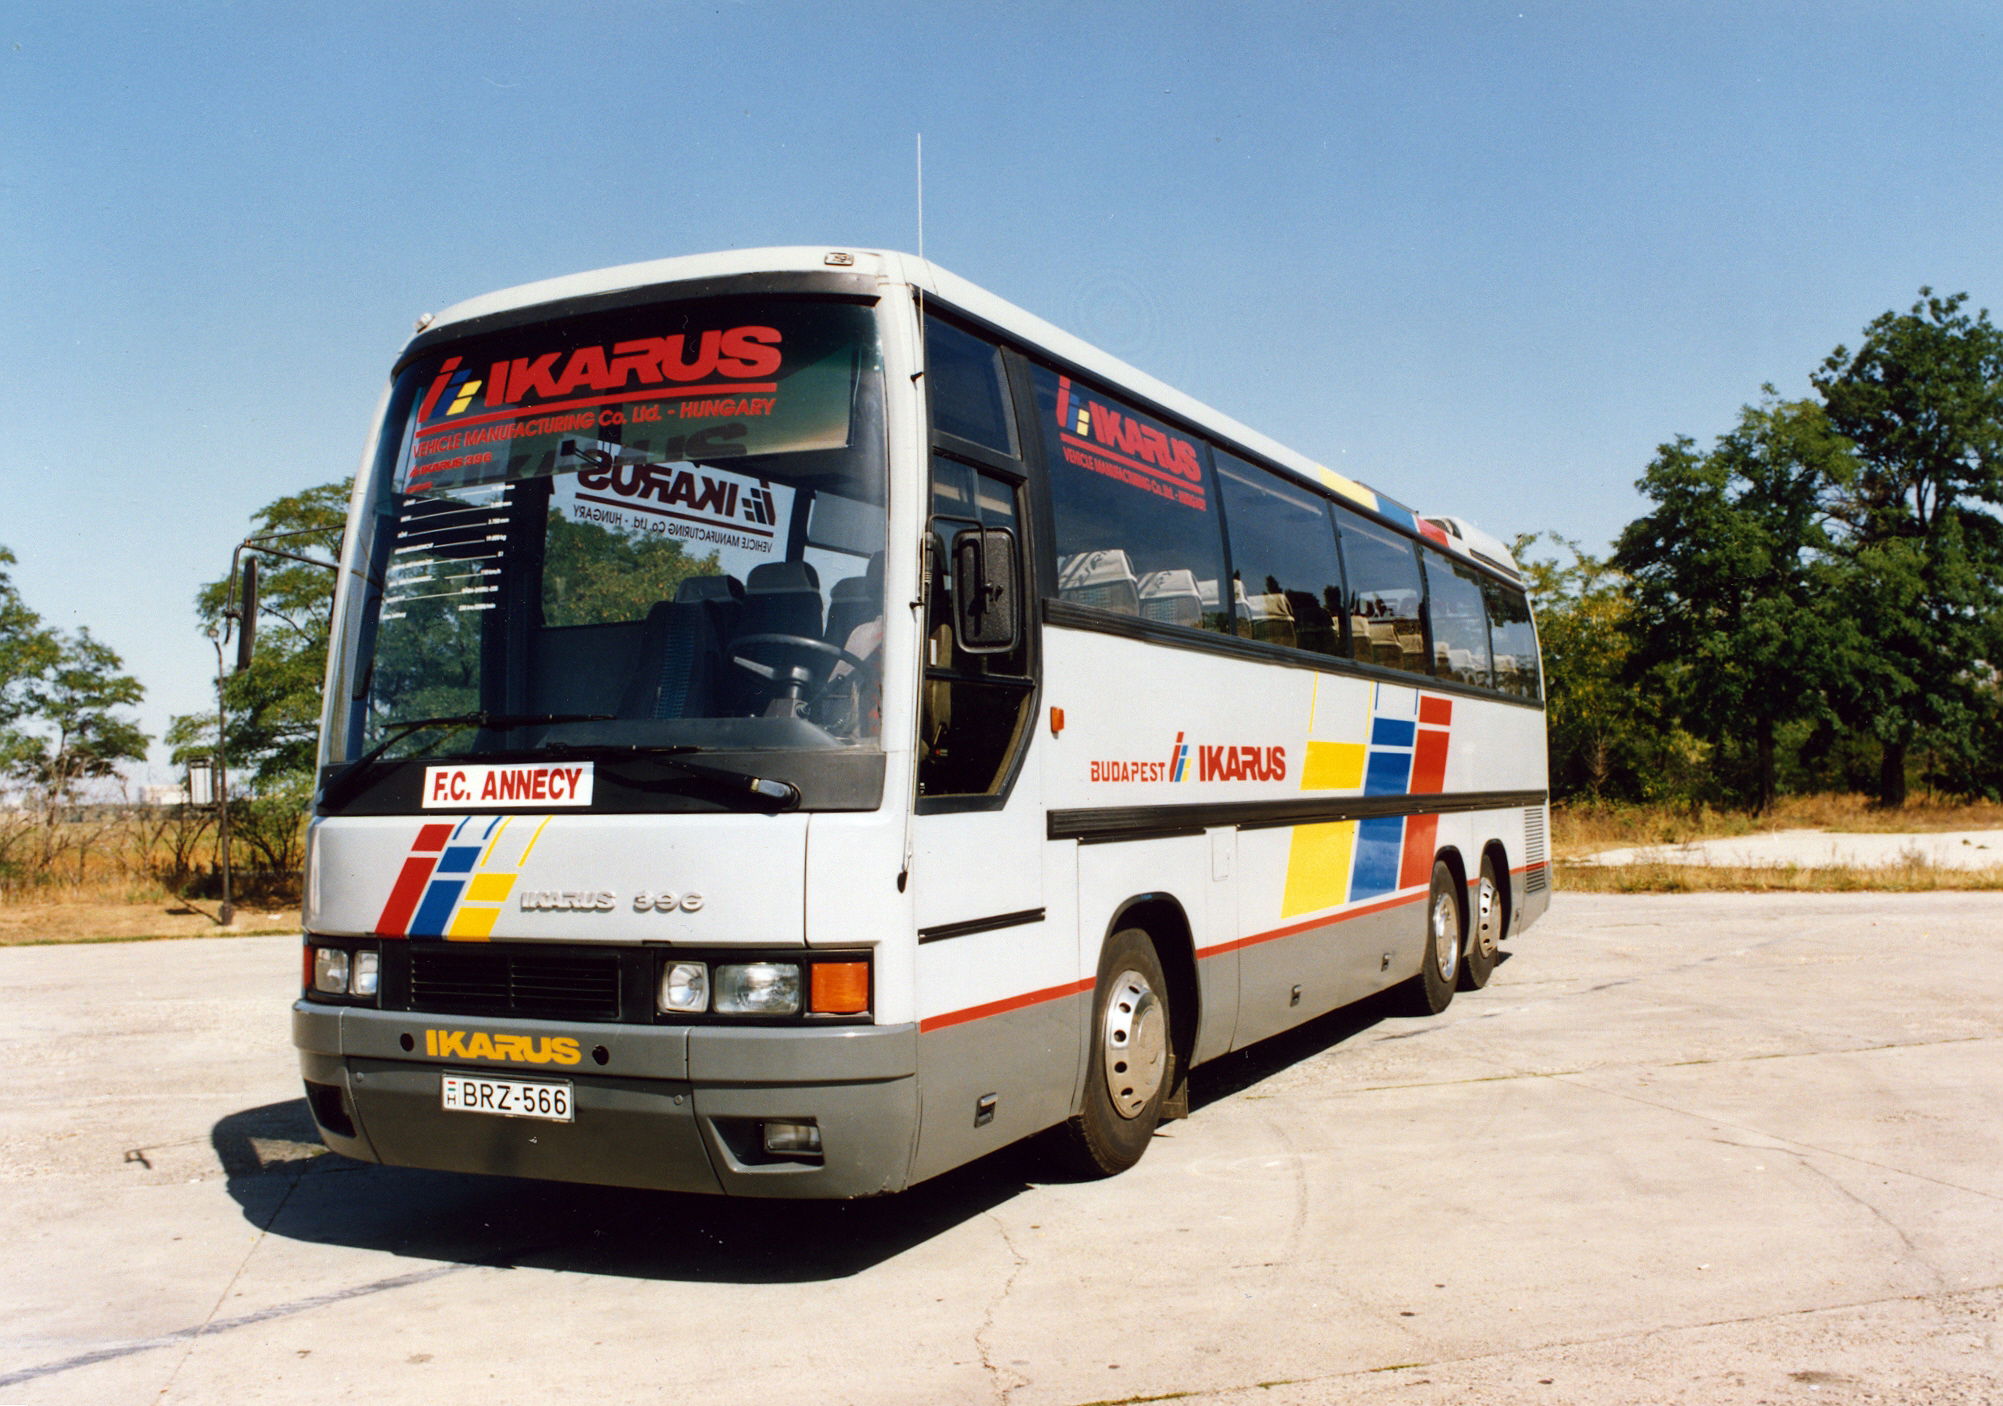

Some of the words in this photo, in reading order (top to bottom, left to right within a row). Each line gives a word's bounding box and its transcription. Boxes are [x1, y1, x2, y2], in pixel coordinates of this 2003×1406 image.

[485, 325, 782, 407] IKARUS
[413, 433, 462, 458] VEHICLE
[464, 412, 596, 448] MANUFACTURING
[599, 410, 627, 427] Co.
[632, 404, 662, 424] Ltd.
[680, 398, 776, 419] HUNGARY
[1089, 400, 1202, 482] IKARUS
[1091, 761, 1165, 782] BUDAPEST
[1199, 745, 1286, 782] IKARUS
[433, 771, 471, 801] F.C.
[481, 767, 583, 801] ANNECY
[520, 890, 616, 912] IKARUS
[632, 890, 705, 914] 396
[425, 1029, 582, 1065] IKARUS
[447, 1093, 456, 1105] H
[463, 1081, 566, 1116] BRZ-566
